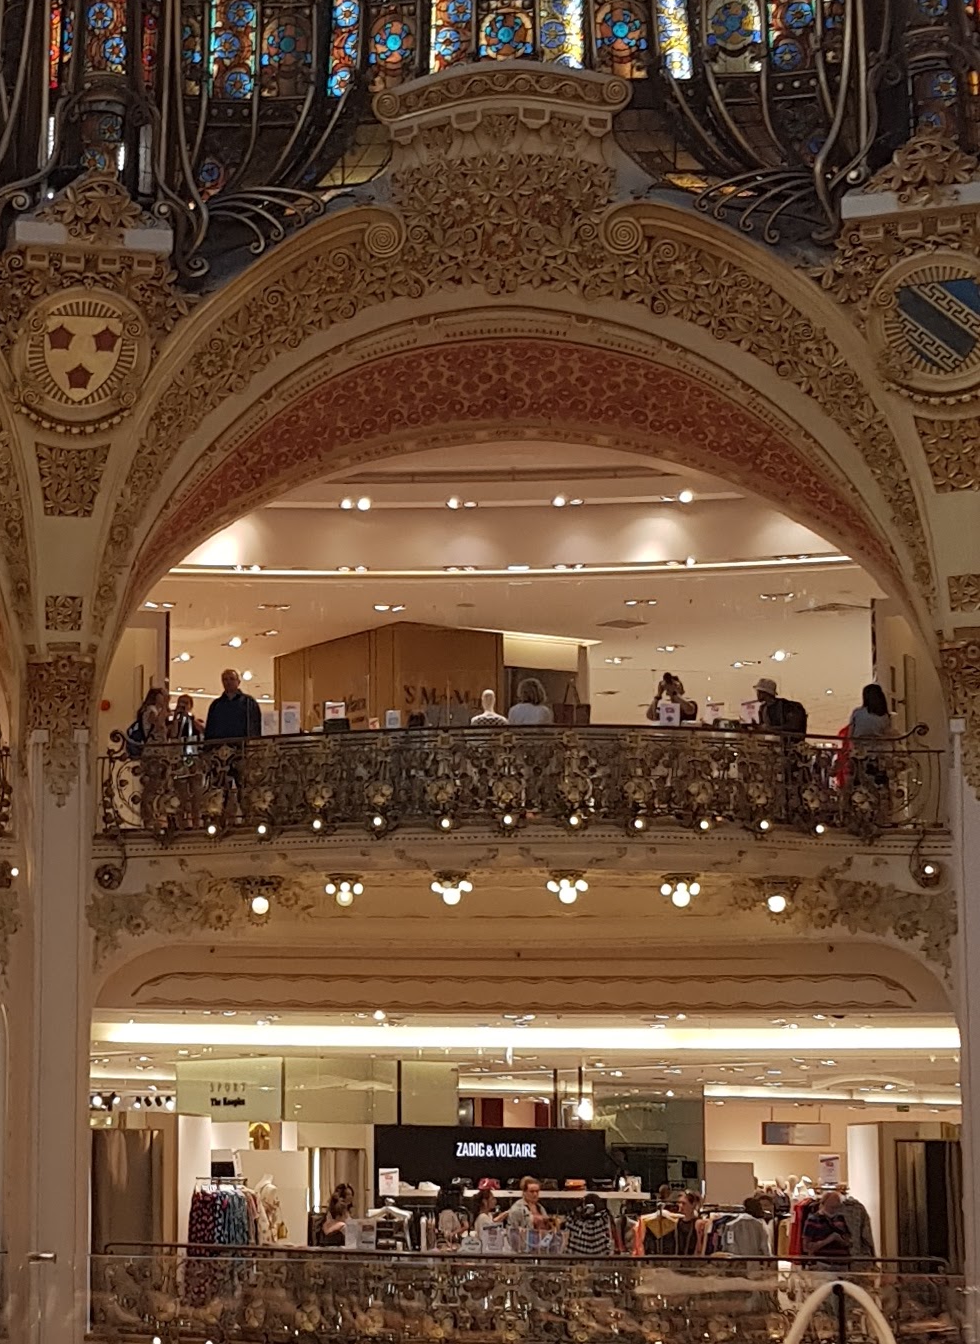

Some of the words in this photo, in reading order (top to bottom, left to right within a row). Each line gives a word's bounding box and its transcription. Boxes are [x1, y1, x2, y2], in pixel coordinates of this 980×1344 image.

[209, 1082, 247, 1093] SPORT
[456, 1142, 485, 1157] ZADIG
[485, 1144, 495, 1158] &
[494, 1143, 537, 1158] VOLTAIRE
